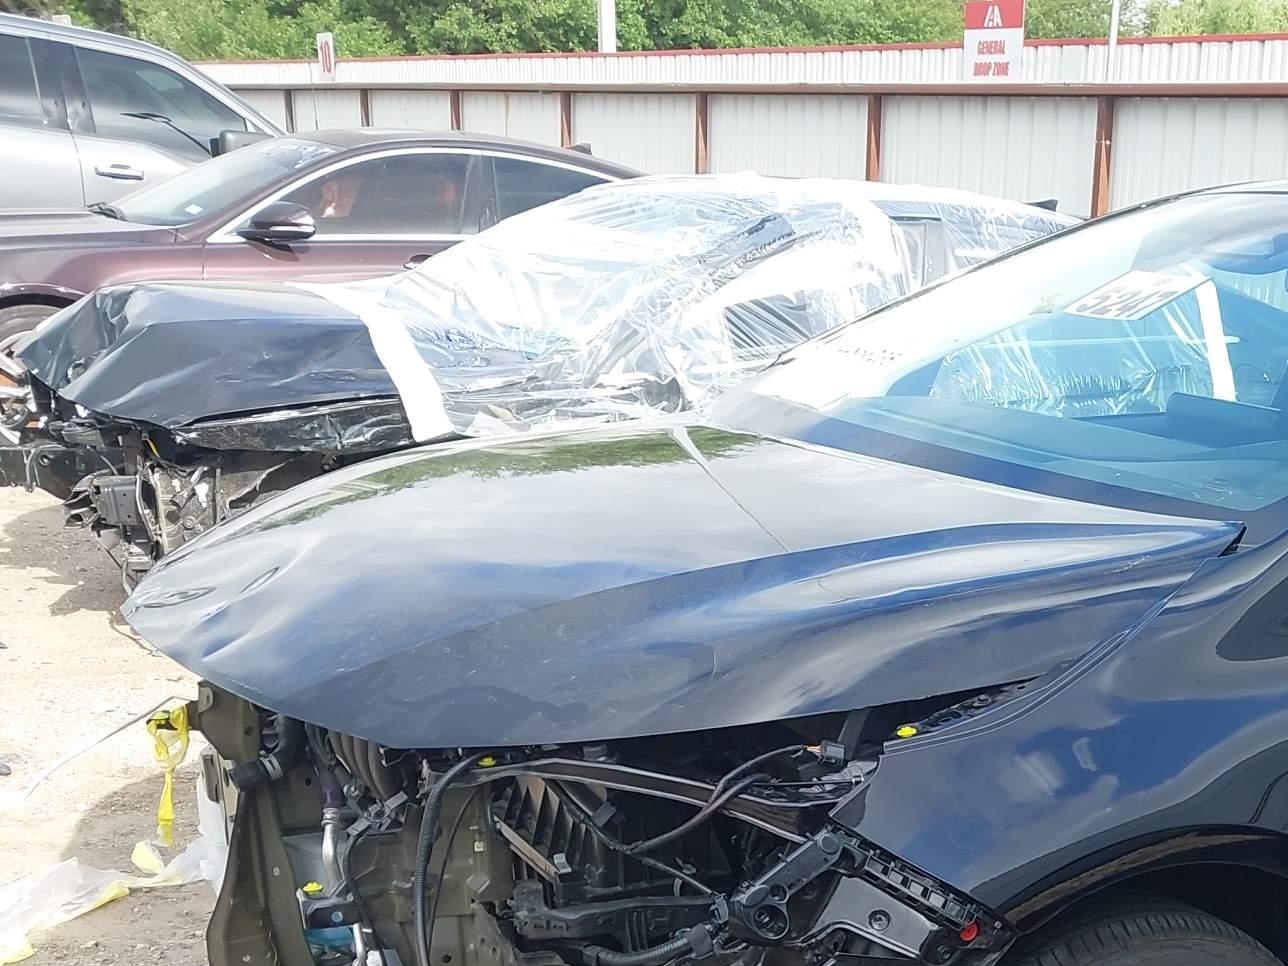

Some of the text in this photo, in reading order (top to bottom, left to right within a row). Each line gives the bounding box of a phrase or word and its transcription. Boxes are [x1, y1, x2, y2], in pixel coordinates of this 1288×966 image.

[977, 39, 1006, 55] GENERAL
[319, 39, 332, 73] 10
[973, 61, 1010, 76] DROP ZONE
